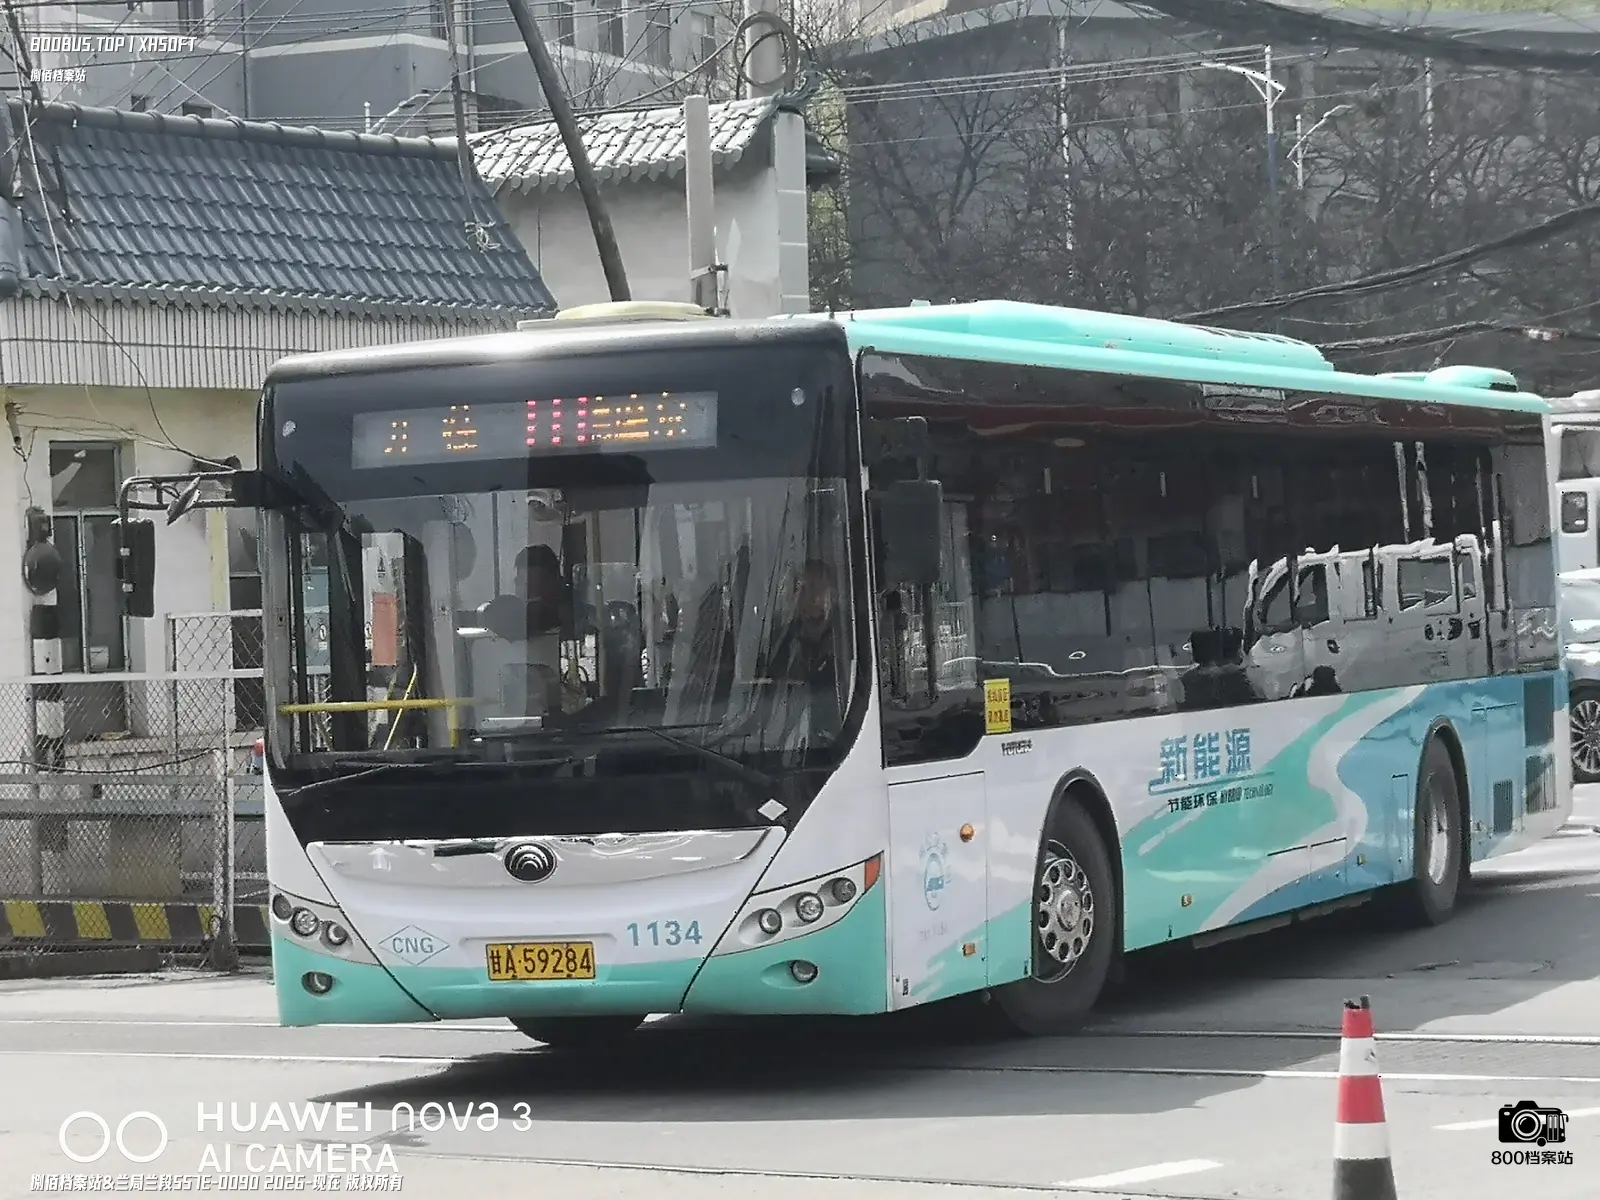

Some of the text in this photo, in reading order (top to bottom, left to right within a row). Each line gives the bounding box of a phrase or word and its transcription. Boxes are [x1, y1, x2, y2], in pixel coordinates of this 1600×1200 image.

[1151, 727, 1251, 784] 新能源
[1167, 791, 1219, 813] 节能环保
[626, 920, 703, 947] 1134
[391, 938, 435, 955] CNG
